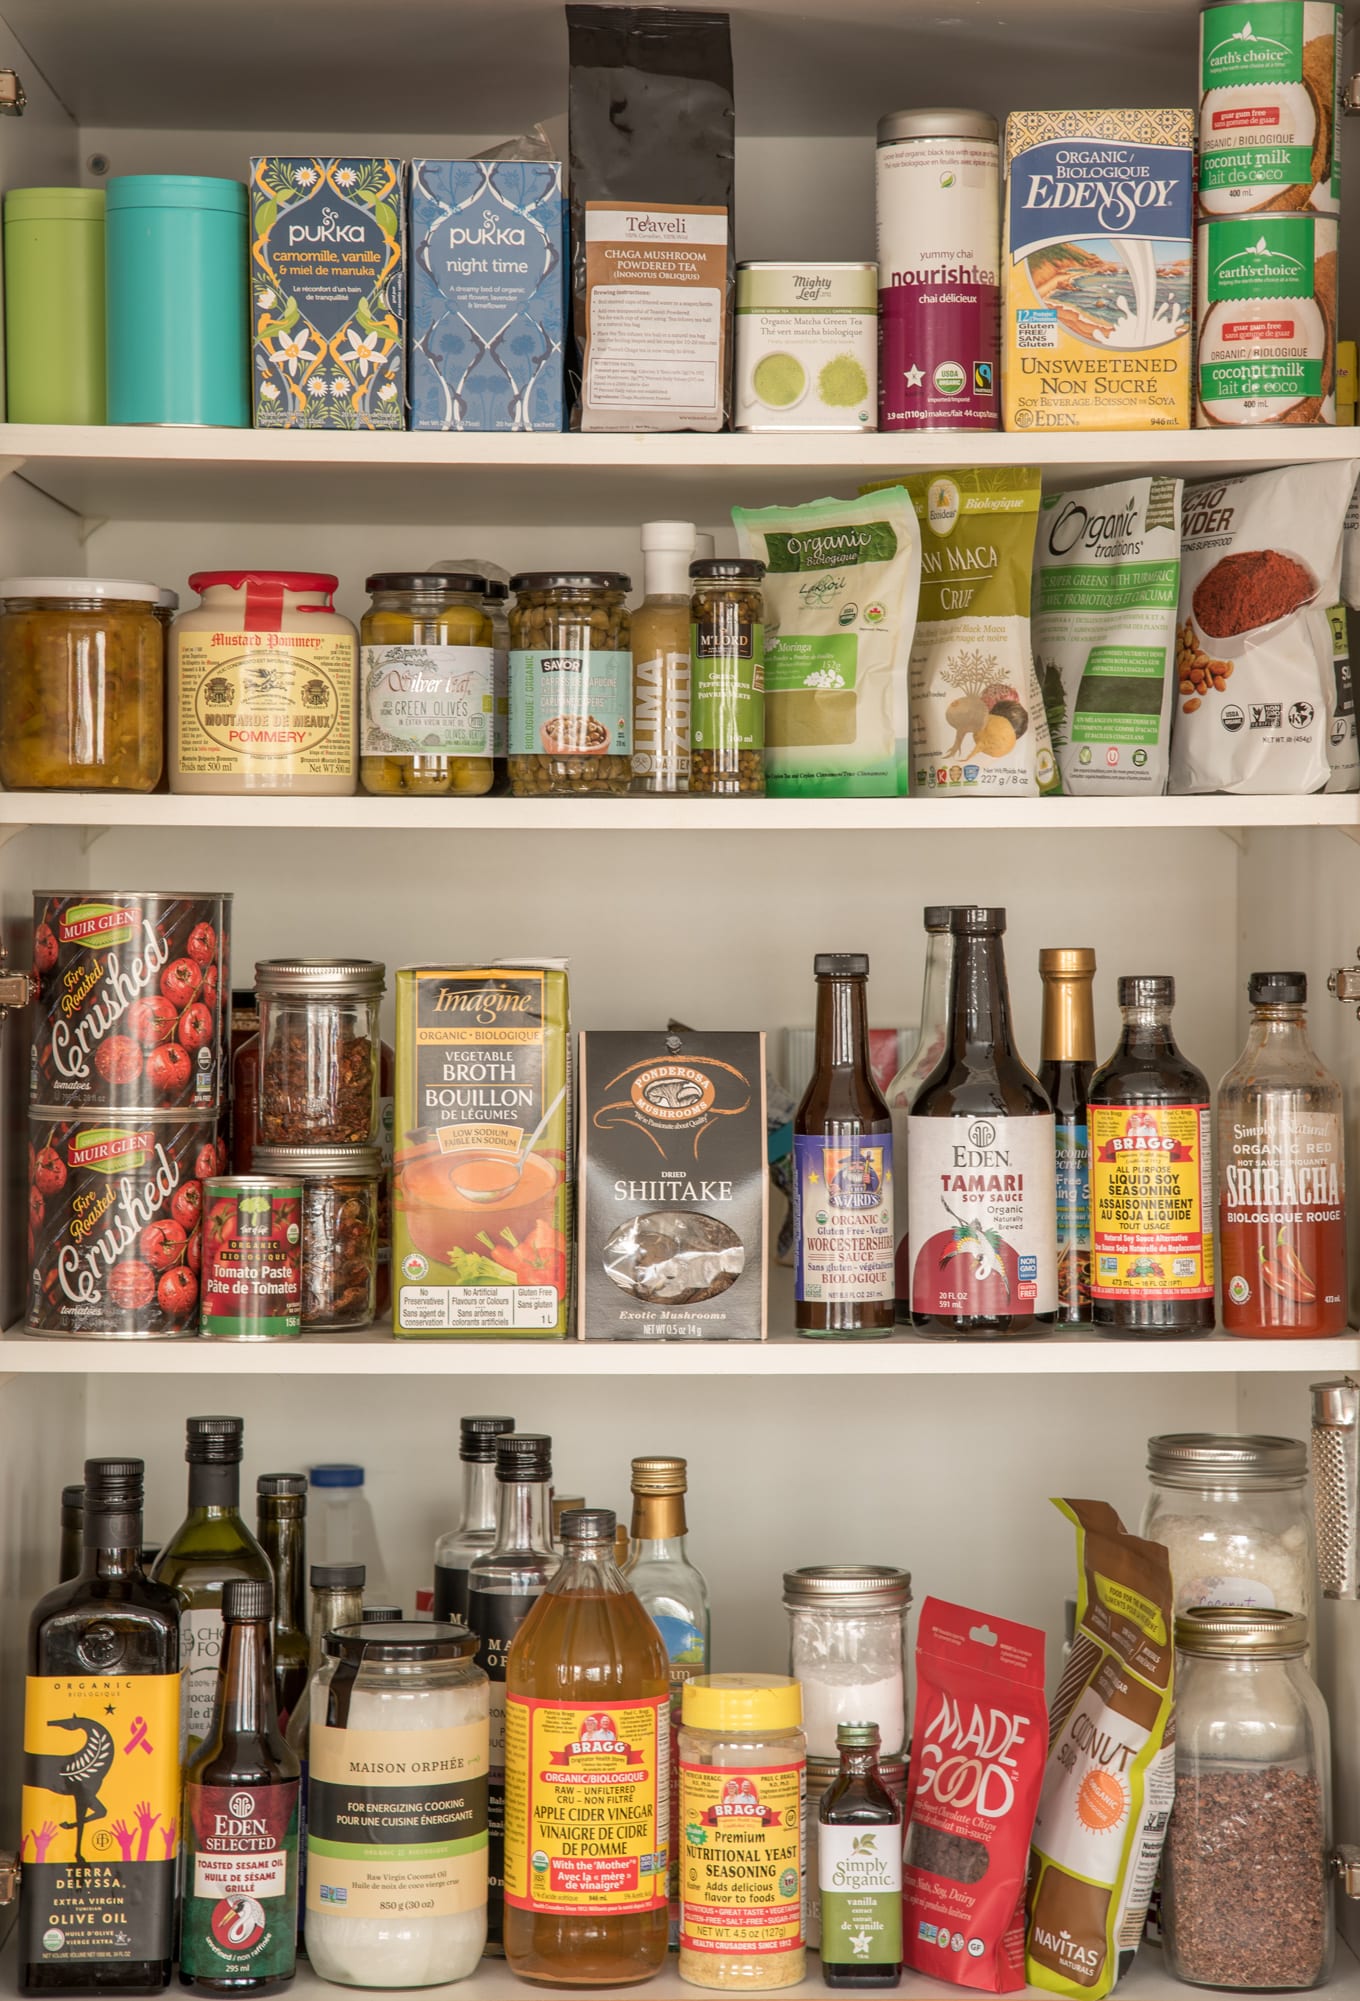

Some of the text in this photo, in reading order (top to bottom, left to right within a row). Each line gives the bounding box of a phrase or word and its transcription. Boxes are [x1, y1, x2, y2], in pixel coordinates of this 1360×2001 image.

[1211, 50, 1285, 66] earth's choice
[1056, 151, 1127, 164] ORGANIC
[1204, 150, 1291, 169] coconut milk
[1056, 166, 1150, 179] BIOLOGIQUE
[289, 217, 365, 245] pukka
[626, 215, 687, 233] Teaveli
[450, 218, 525, 248] pukka
[273, 250, 381, 263] camomille, vanille
[605, 250, 707, 261] CHAGA MUSHROOM
[920, 249, 974, 261] yummy chai
[279, 265, 374, 276] & miel de manuka
[447, 259, 528, 275] night time
[618, 261, 696, 271] POWDERED TEA
[793, 275, 832, 289] Mighty
[892, 264, 994, 287] nourishtea
[796, 288, 820, 300] Leaf
[919, 294, 977, 303] chai délicieux
[761, 318, 792, 326] Organic
[1021, 358, 1177, 374] UNSWEETENED
[1040, 376, 1157, 394] NON SUCRÉ
[1036, 411, 1075, 426] EDEN
[965, 498, 1024, 510] Biologique
[1050, 501, 1137, 555] Organic
[788, 530, 871, 557] Organic
[921, 546, 998, 573] AW MACA
[211, 634, 321, 649] Mustard Pommery
[701, 635, 748, 646] M'LORD
[778, 642, 812, 652] Moringa
[544, 661, 580, 672] SAVOR
[395, 701, 468, 716] GREEN OLIVES
[525, 656, 534, 749] BIOLOGIQUE ORGANIC
[635, 658, 663, 750] LIMA
[229, 730, 306, 743] POMMERY
[981, 775, 997, 783] 227
[1000, 777, 1004, 785] g
[1012, 775, 1018, 783] 8
[64, 911, 136, 939] MUIR GLEN
[63, 967, 84, 992] Fire
[61, 959, 104, 1019] Roasted
[52, 920, 169, 1078] Crushed
[432, 987, 532, 1024] Imagine
[420, 1031, 539, 1041] ORGANIC BIOLOGIQUE
[445, 1052, 513, 1061] VEGETABLE
[443, 1064, 515, 1081] BROTH
[635, 1068, 710, 1088] PONDEROSA
[53, 1080, 91, 1090] tomatoes
[426, 1090, 532, 1107] BOUILLON
[442, 1108, 517, 1120] DE LÉGUMES
[637, 1099, 707, 1118] MUSHROOMS
[74, 1135, 148, 1164] MUIR GLEN
[1113, 1138, 1174, 1150] BRAGG
[952, 1145, 1009, 1168] EDEN
[941, 1174, 1023, 1192] TAMARI
[1110, 1174, 1179, 1184] LIQUID SOY
[1226, 1163, 1340, 1207] SRIRACHA
[614, 1181, 732, 1201] SHIITAKE
[1109, 1186, 1180, 1195] SEASONING
[962, 1194, 1023, 1202] SOY SAUCE
[1099, 1199, 1192, 1209] ASSAISONNEMENT
[988, 1205, 1023, 1215] Organic
[1228, 1210, 1340, 1224] BIOLOGIQUE ROUGE
[58, 1143, 179, 1304] Crushed
[832, 1215, 878, 1225] ORGANIC
[807, 1236, 892, 1251] WORCESTERSHIRE
[838, 1252, 874, 1262] SAUCE
[214, 1265, 292, 1278] Tomato Paste
[207, 1280, 296, 1294] Pâte de Tomates
[404, 1297, 444, 1305] Preservatives
[620, 1312, 726, 1320] Exotic Mushrooms
[925, 1692, 1030, 1767] MADE
[572, 1742, 625, 1753] BRAGG
[350, 1757, 464, 1773] MAISON ORPHÉE
[916, 1744, 1014, 1817] GOOD
[555, 1786, 635, 1794] RAW UNFILTERED
[348, 1799, 464, 1812] FOR ENERGIZING COOKING
[534, 1804, 653, 1821] APPLE CIDER VINEGAR
[715, 1805, 766, 1816] BRAGG
[337, 1810, 473, 1826] POUR UNE CUISINE ÉNERGISANTE
[215, 1815, 266, 1836] EDEN
[540, 1824, 647, 1840] VINAIGRE DE CIDRE
[206, 1837, 276, 1851] SELECTED
[687, 1845, 797, 1862] NUTRITIONAL YEAST
[197, 1859, 283, 1869] TOASTED SESAME OIL
[836, 1858, 887, 1875] Simply
[66, 1868, 112, 1877] TERRA
[706, 1865, 776, 1878] SEASONING
[56, 1878, 121, 1889] DELYSSA
[832, 1872, 892, 1889] Organic
[847, 1897, 878, 1905] vanilla
[49, 1914, 128, 1925] OLIVE OIL
[1035, 1927, 1099, 1966] NAVITAS
[1059, 1958, 1095, 1977] NATURALS
